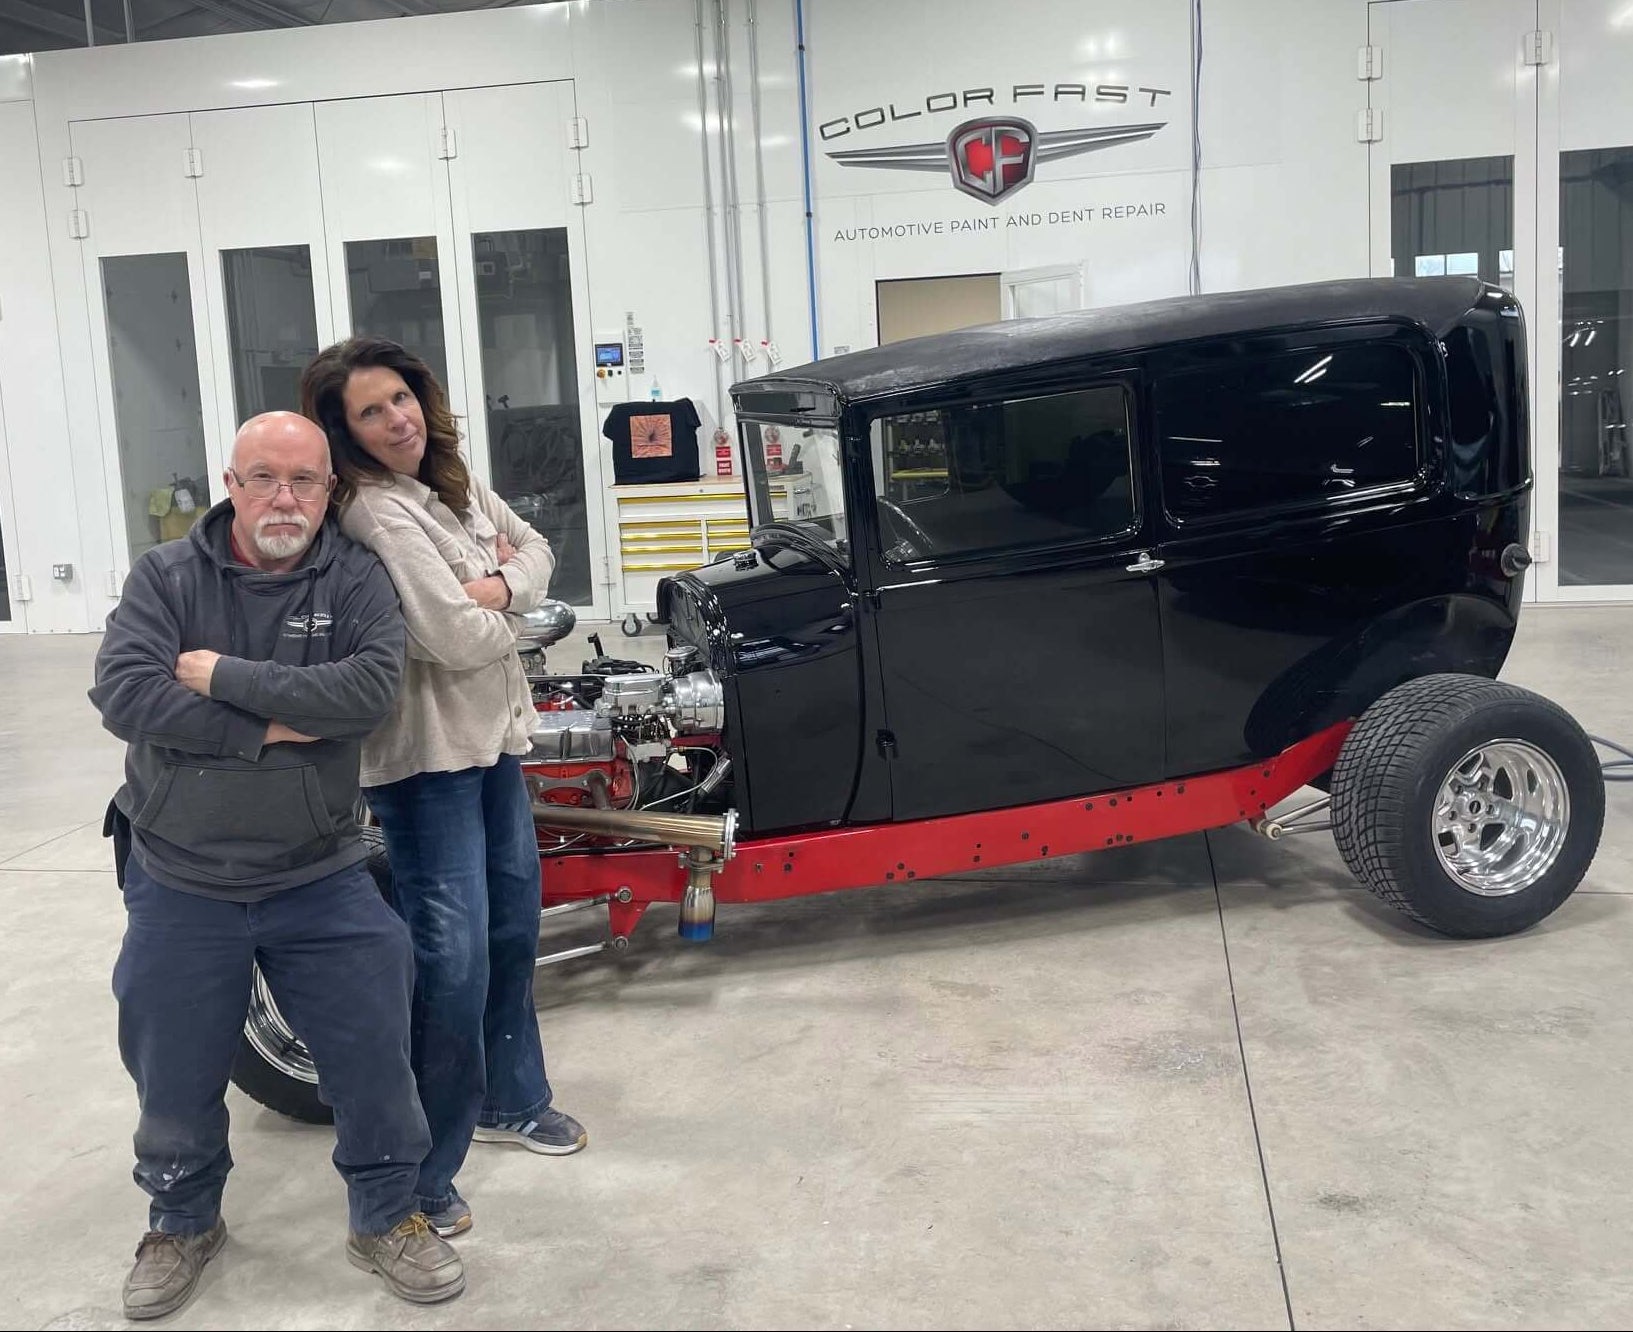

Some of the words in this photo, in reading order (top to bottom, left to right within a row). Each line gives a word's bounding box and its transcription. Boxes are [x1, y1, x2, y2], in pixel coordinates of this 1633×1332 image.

[819, 88, 994, 140] COLOR
[1013, 84, 1171, 107] FAST
[834, 221, 944, 242] AUTOMOTIVE
[950, 217, 999, 233] PAINT
[1006, 213, 1042, 228] AND
[1048, 208, 1095, 224] DENT
[1102, 202, 1166, 220] REPAIR
